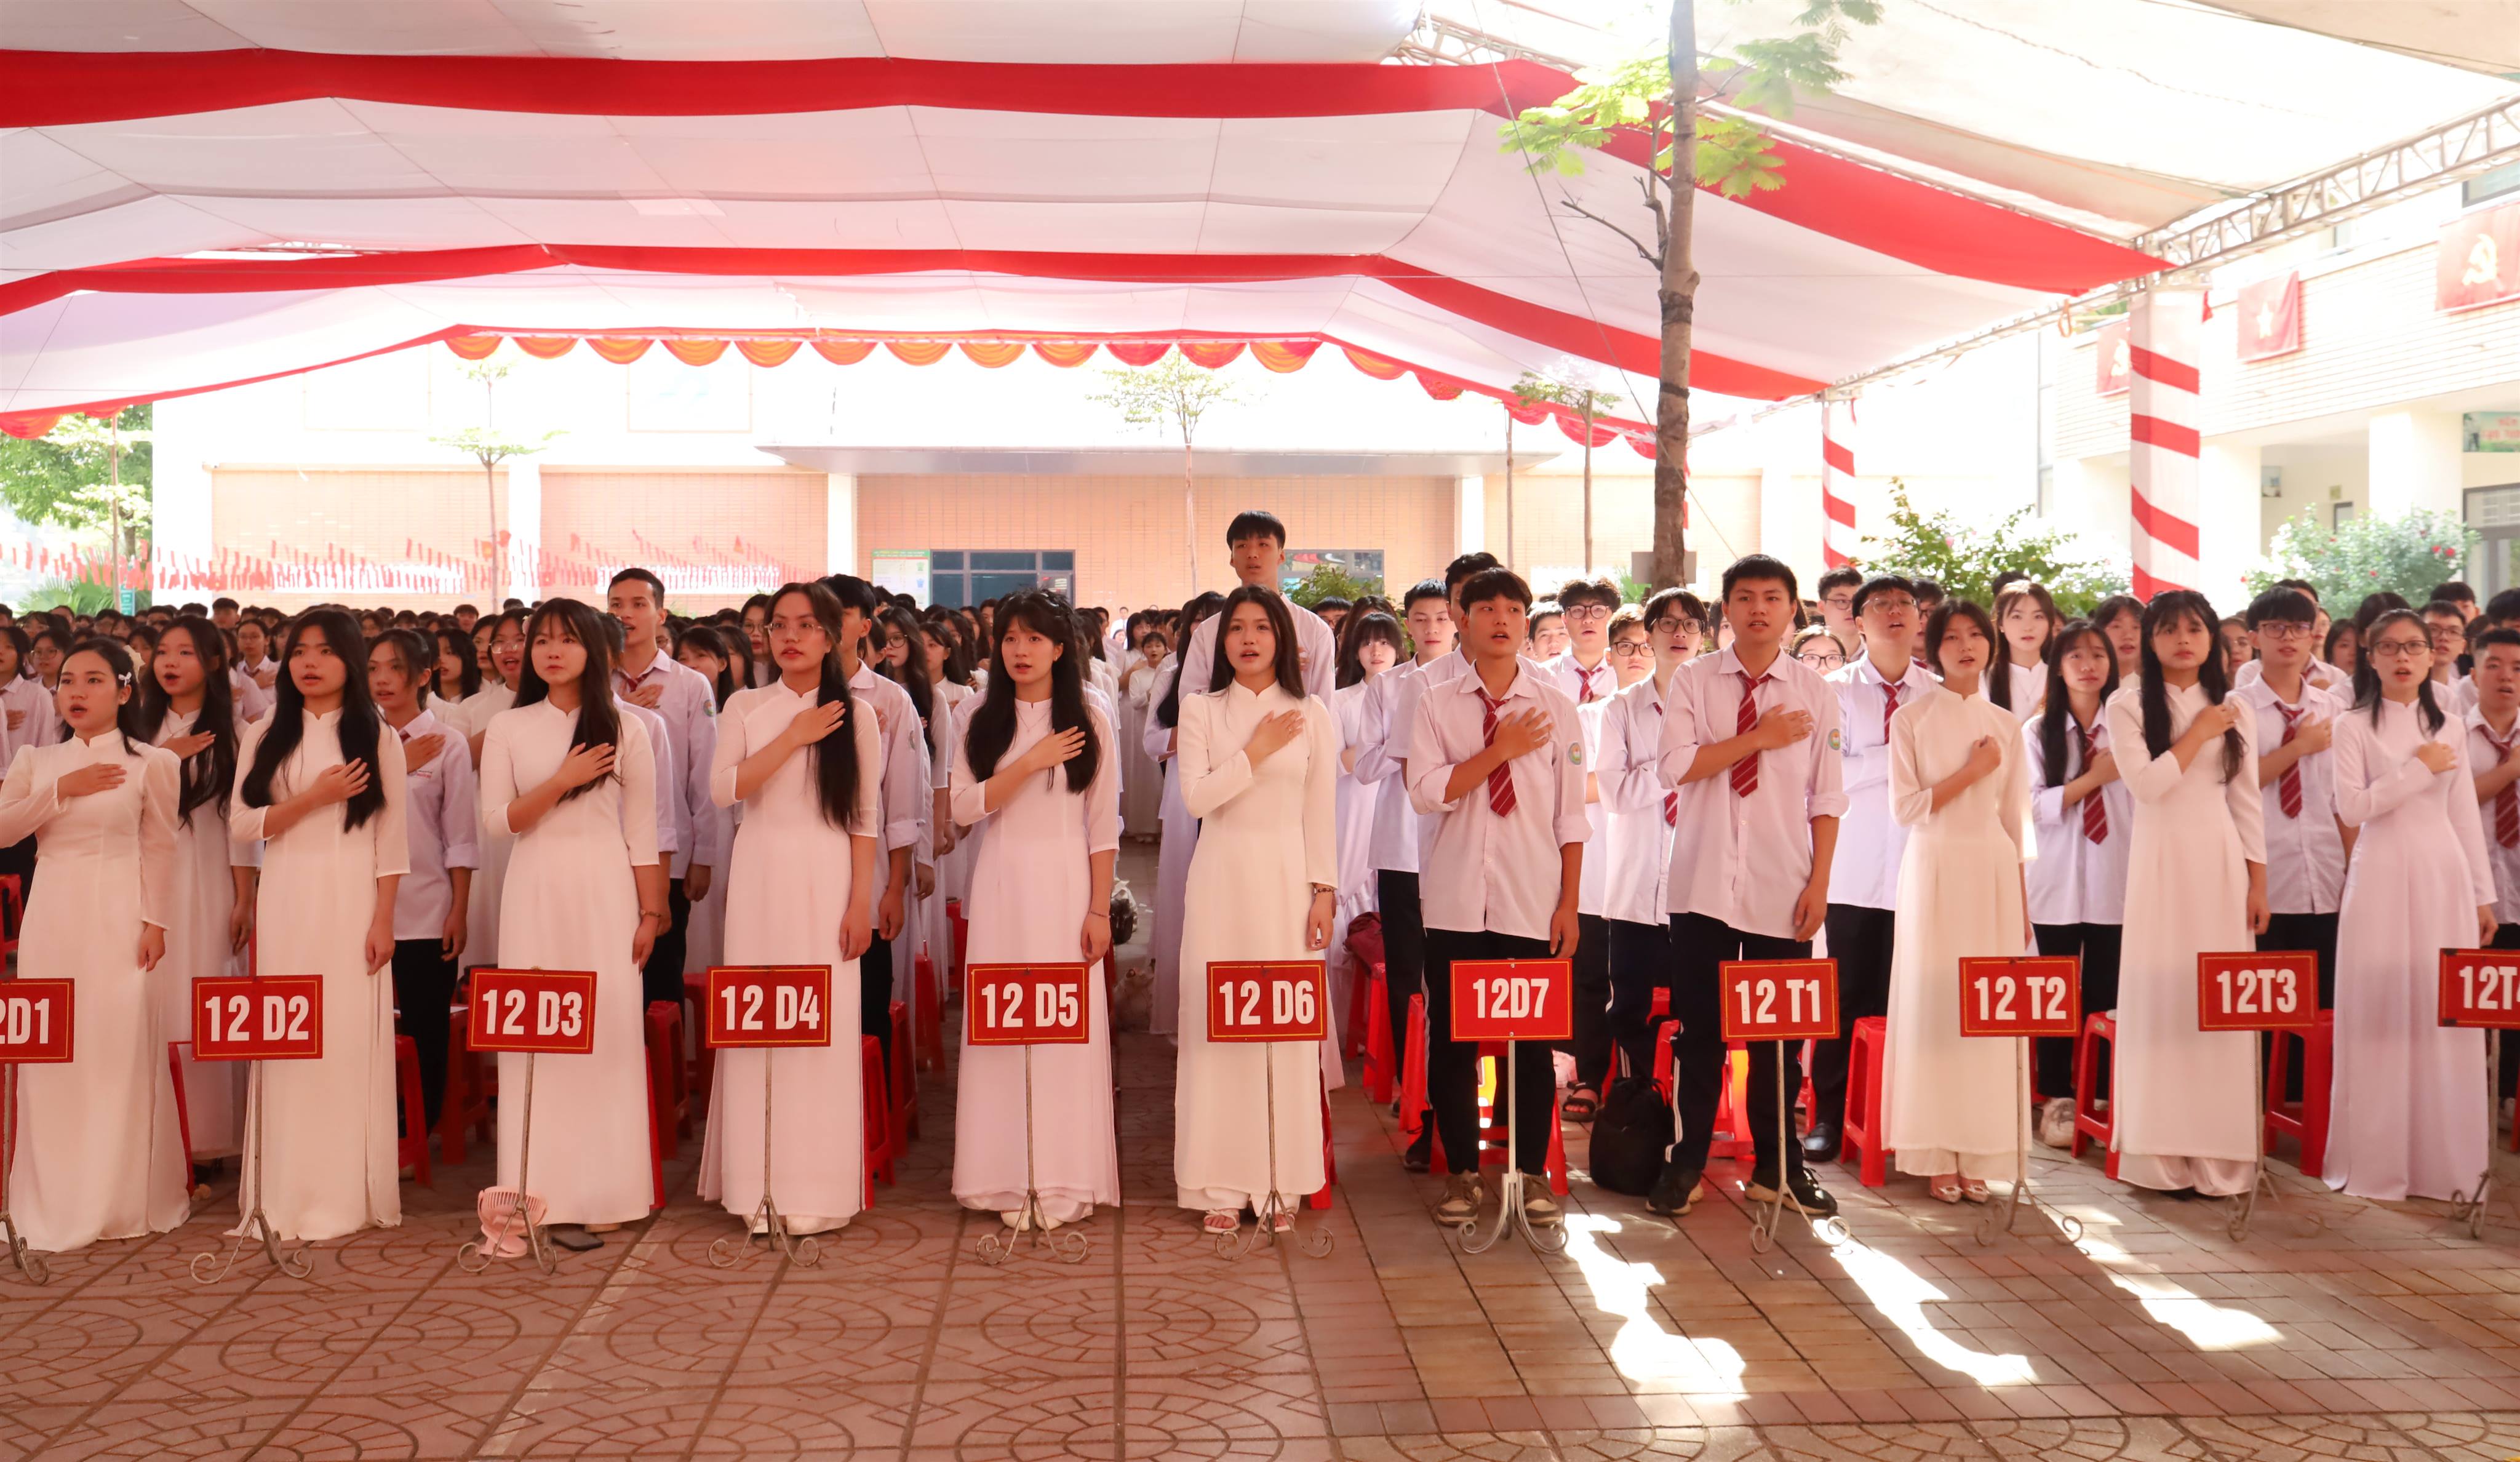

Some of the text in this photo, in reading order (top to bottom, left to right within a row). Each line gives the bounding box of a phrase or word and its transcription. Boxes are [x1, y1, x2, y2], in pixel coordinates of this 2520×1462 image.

[722, 985, 819, 1029] 12 D4
[982, 983, 1078, 1028] 12 D5
[1220, 981, 1314, 1026] 12 D6
[1473, 978, 1549, 1018] 12D7
[1736, 979, 1820, 1024] 12 T1
[1974, 977, 2066, 1020] 12 T2
[2217, 969, 2296, 1013] 12T3
[2460, 966, 2520, 1010] 12T
[0, 998, 49, 1044] D1
[206, 996, 308, 1041] 12 D2
[483, 989, 582, 1037] 12 D3
